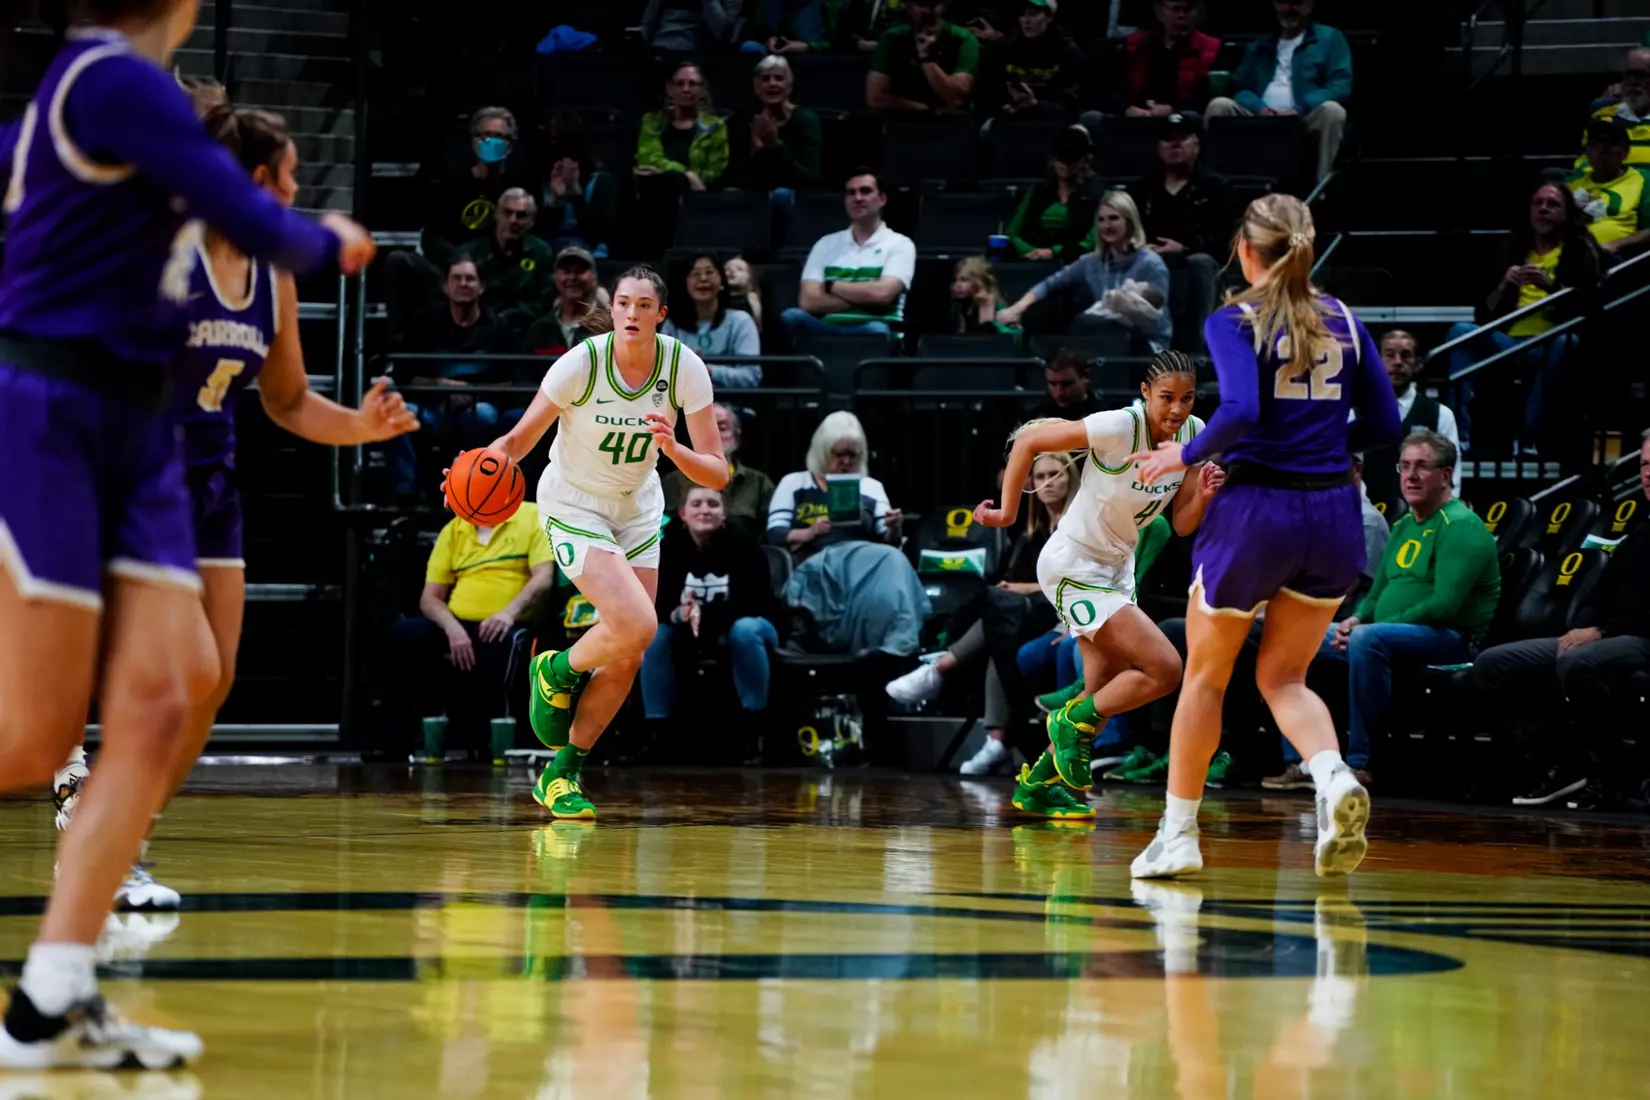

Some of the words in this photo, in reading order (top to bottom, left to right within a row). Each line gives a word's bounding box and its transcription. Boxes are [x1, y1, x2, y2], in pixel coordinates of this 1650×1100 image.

[1273, 335, 1343, 400] 22
[595, 415, 657, 426] DUCK
[598, 432, 653, 465] 40
[1131, 480, 1182, 494] DUCKS
[1133, 500, 1162, 526] 4
[556, 542, 575, 567] O
[1395, 539, 1422, 569] O
[1070, 600, 1096, 626] O
